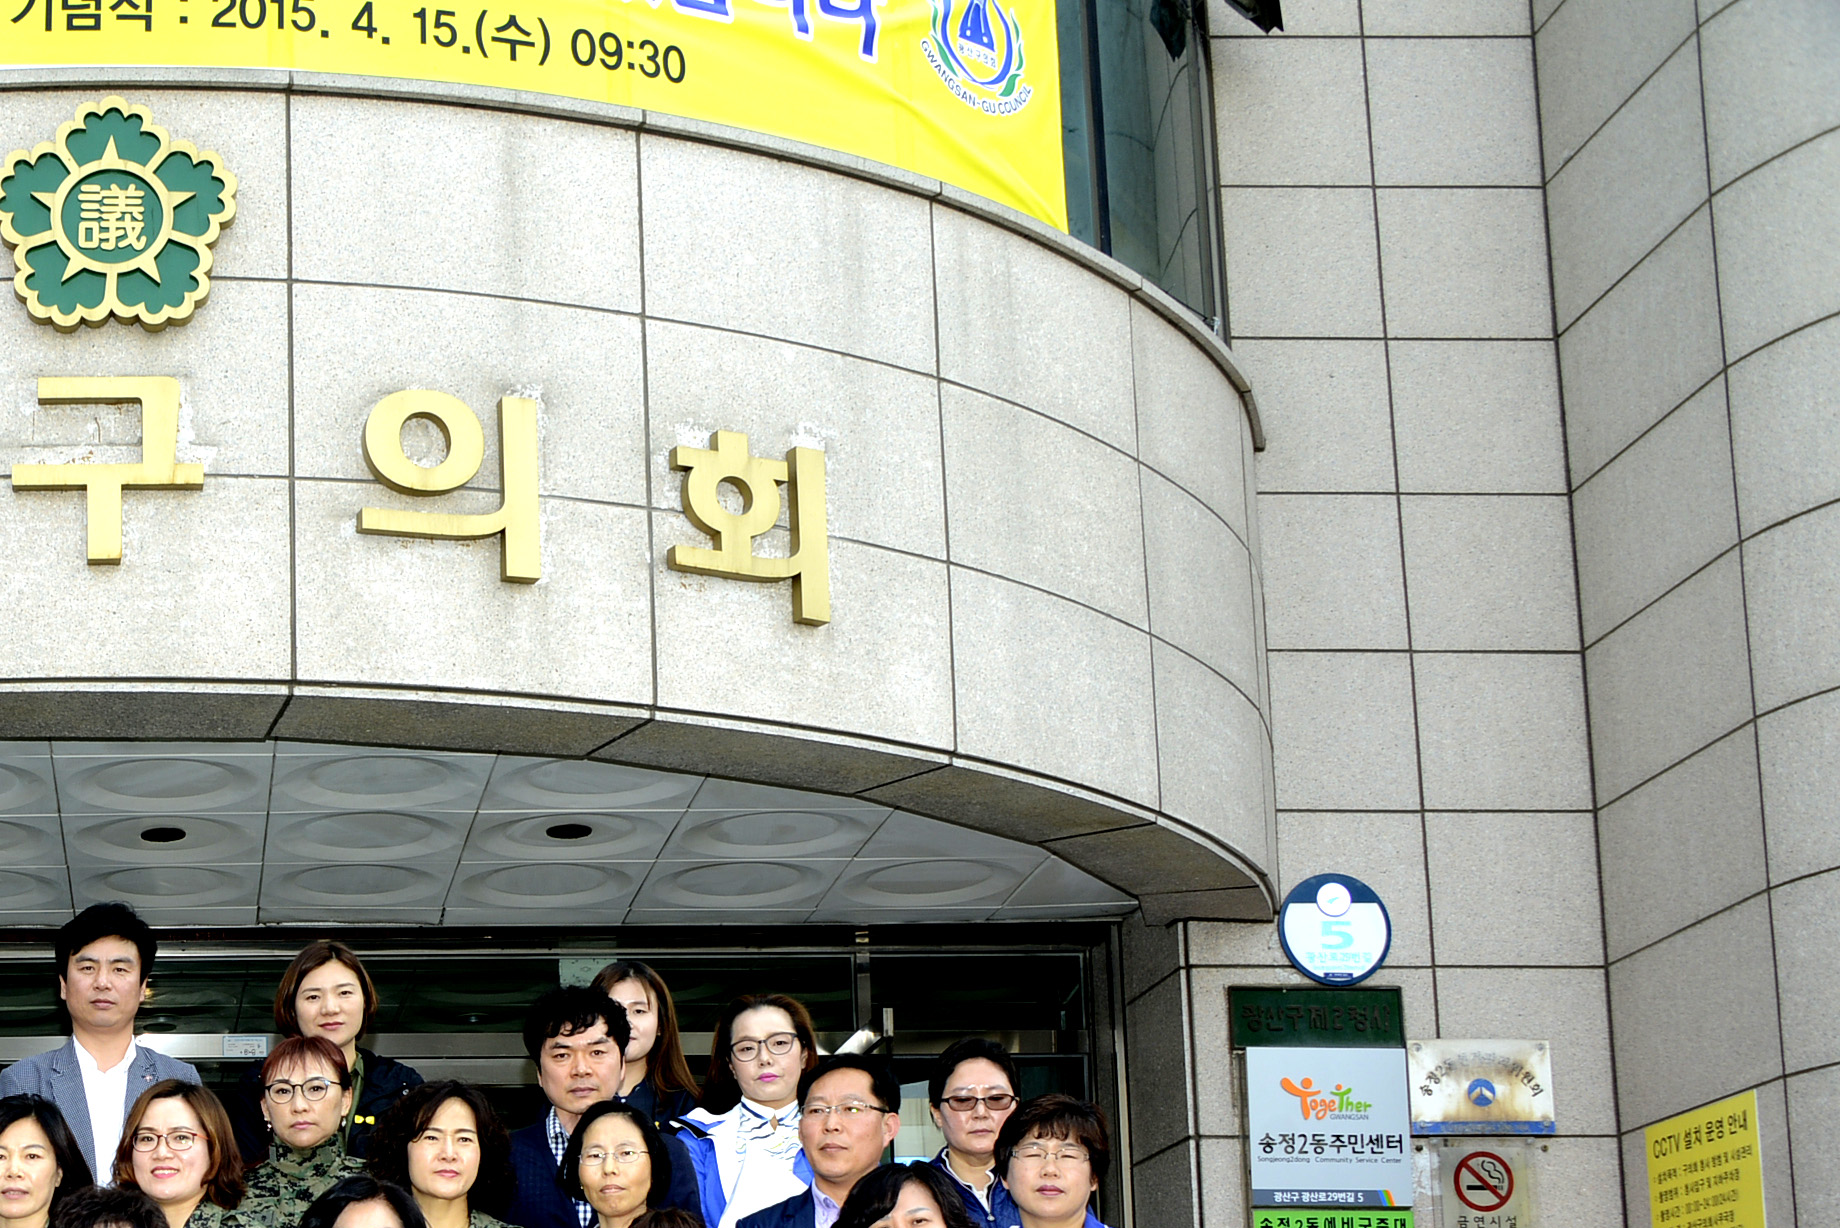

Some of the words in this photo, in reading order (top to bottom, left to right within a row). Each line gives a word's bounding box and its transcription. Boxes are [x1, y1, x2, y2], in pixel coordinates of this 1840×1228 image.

[11, 0, 152, 32] 기념식
[212, 0, 330, 38] 2015.
[351, 4, 391, 44] 4.
[571, 28, 686, 83] 09:30
[921, 40, 996, 114] GWANGSAN-GU
[77, 183, 147, 250] 議
[1320, 920, 1355, 950] 5
[1329, 1113, 1370, 1121] GWANGSAN
[1258, 1132, 1404, 1155] 송정2동주민센터
[1652, 1133, 1680, 1159] CCTV
[1684, 1124, 1703, 1150] 설치
[1705, 1117, 1725, 1143] 운영
[1727, 1109, 1748, 1136] 안내
[1257, 1155, 1311, 1164] Songjeong2dong
[1315, 1156, 1353, 1164] Community
[1355, 1156, 1378, 1164] Service
[1380, 1156, 1402, 1164] Center
[1273, 1191, 1301, 1203] 광산구
[1301, 1191, 1355, 1203] 광산로29번길
